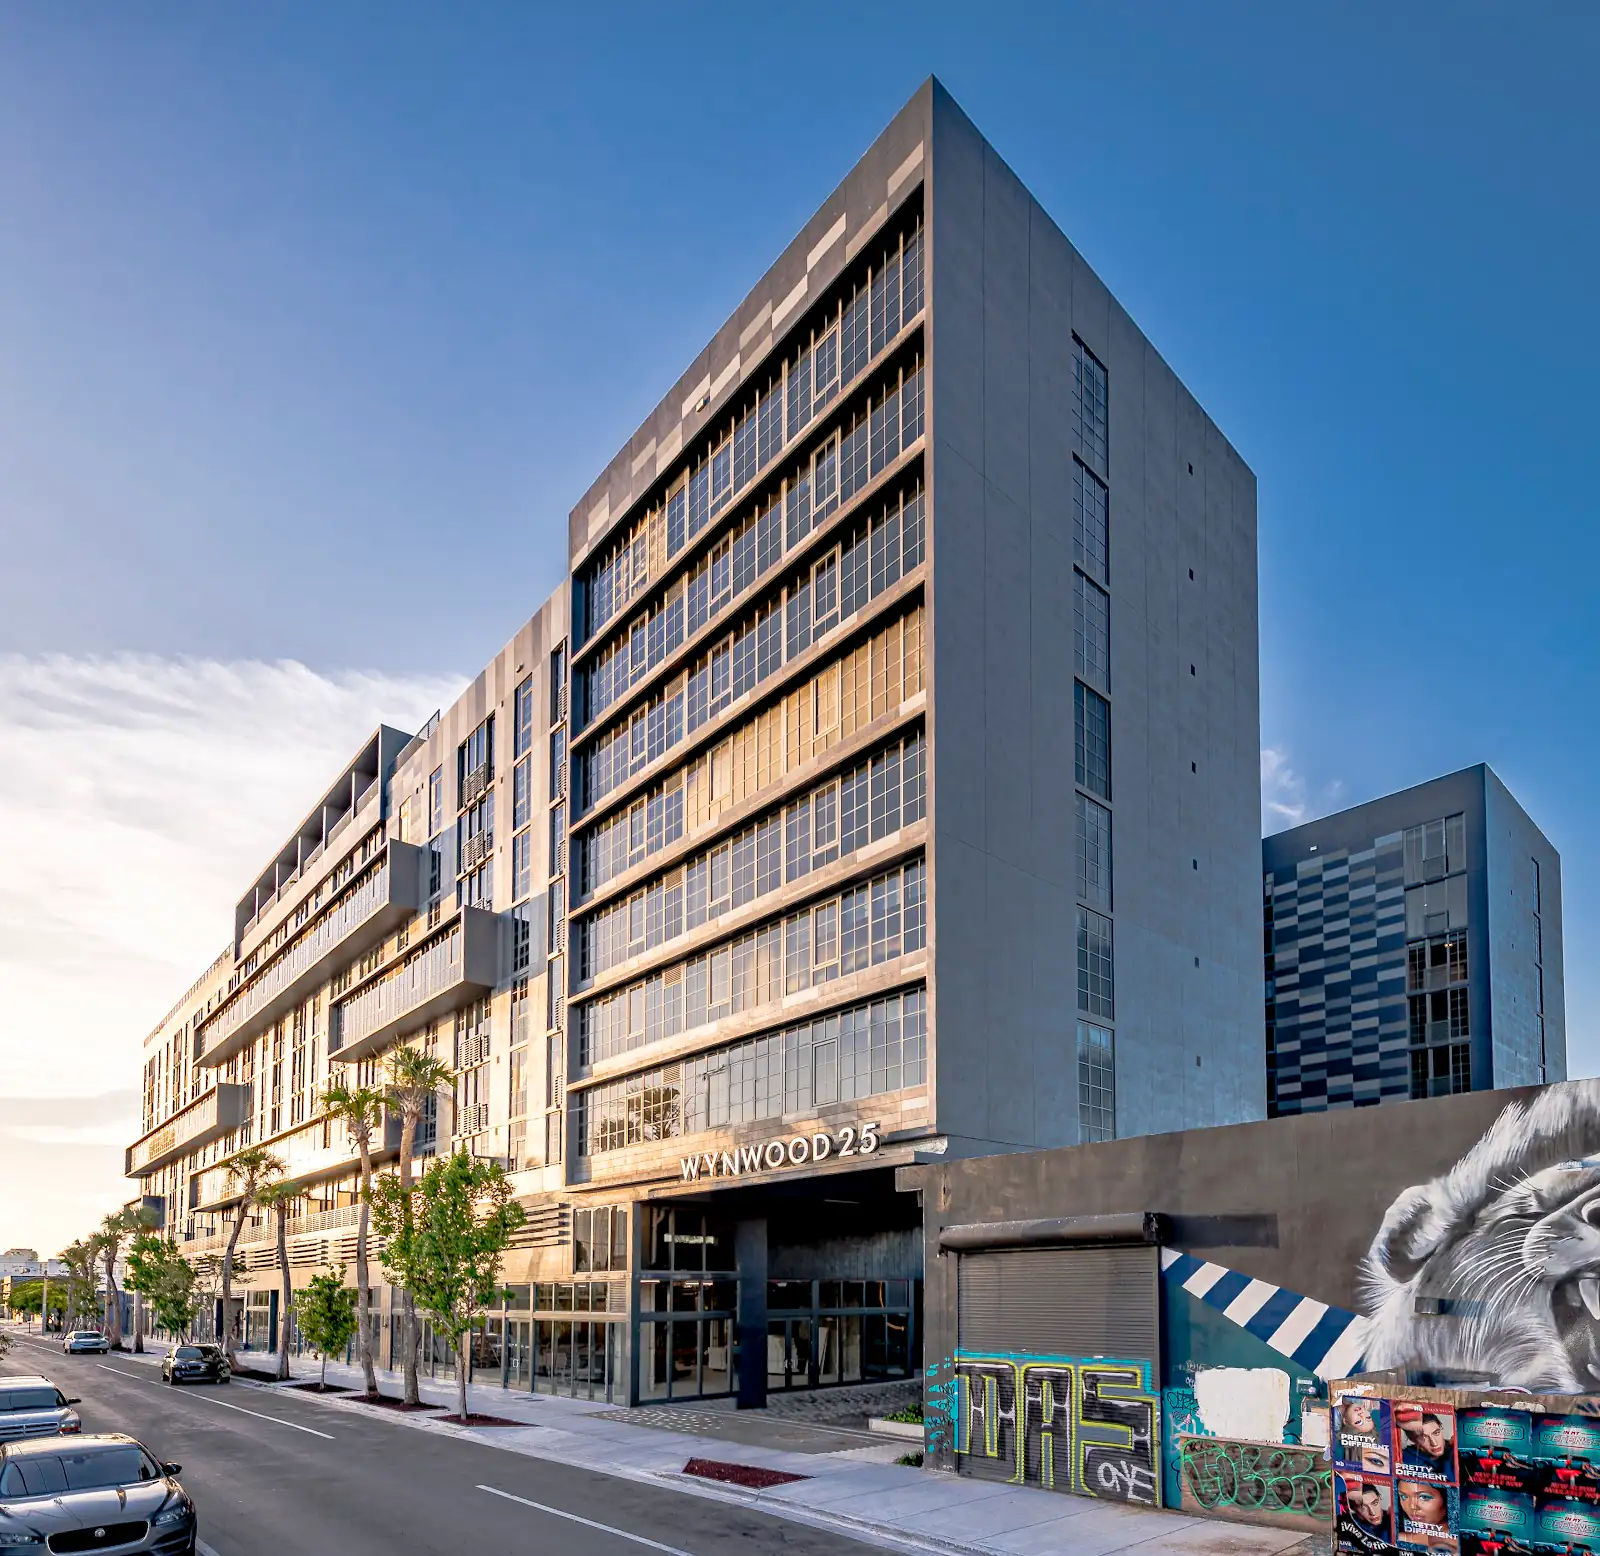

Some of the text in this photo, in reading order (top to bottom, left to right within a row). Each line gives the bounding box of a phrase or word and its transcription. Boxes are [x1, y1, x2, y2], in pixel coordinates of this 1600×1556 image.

[680, 1122, 880, 1181] WYNWOOD 25
[1340, 1433, 1376, 1443] PRETTY
[1340, 1440, 1389, 1451] DIFFERENT
[1395, 1462, 1433, 1473] PRETTY
[1395, 1469, 1448, 1482] DIFFERENT
[1404, 1519, 1443, 1531] PRETTY
[1404, 1526, 1459, 1540] DIFFERENT
